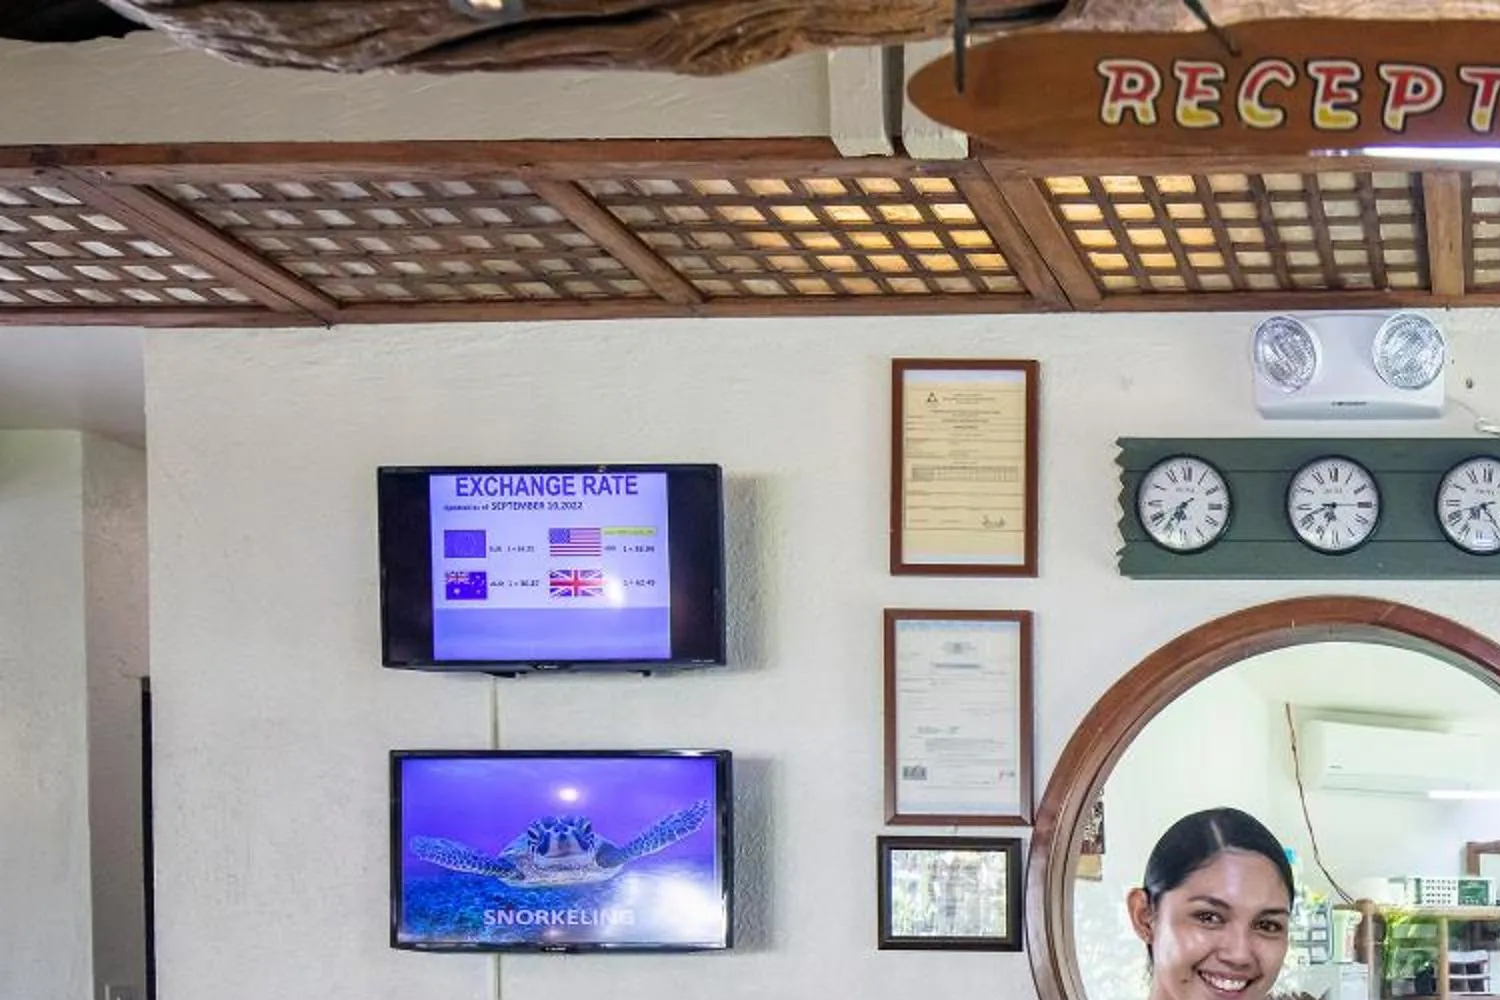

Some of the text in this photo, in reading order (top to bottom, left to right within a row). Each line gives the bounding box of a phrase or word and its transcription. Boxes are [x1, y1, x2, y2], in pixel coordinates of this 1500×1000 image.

[455, 475, 639, 497] EXCHANGE RATE
[491, 501, 545, 511] SEPTEMBER
[483, 909, 635, 926] SNORKELING
